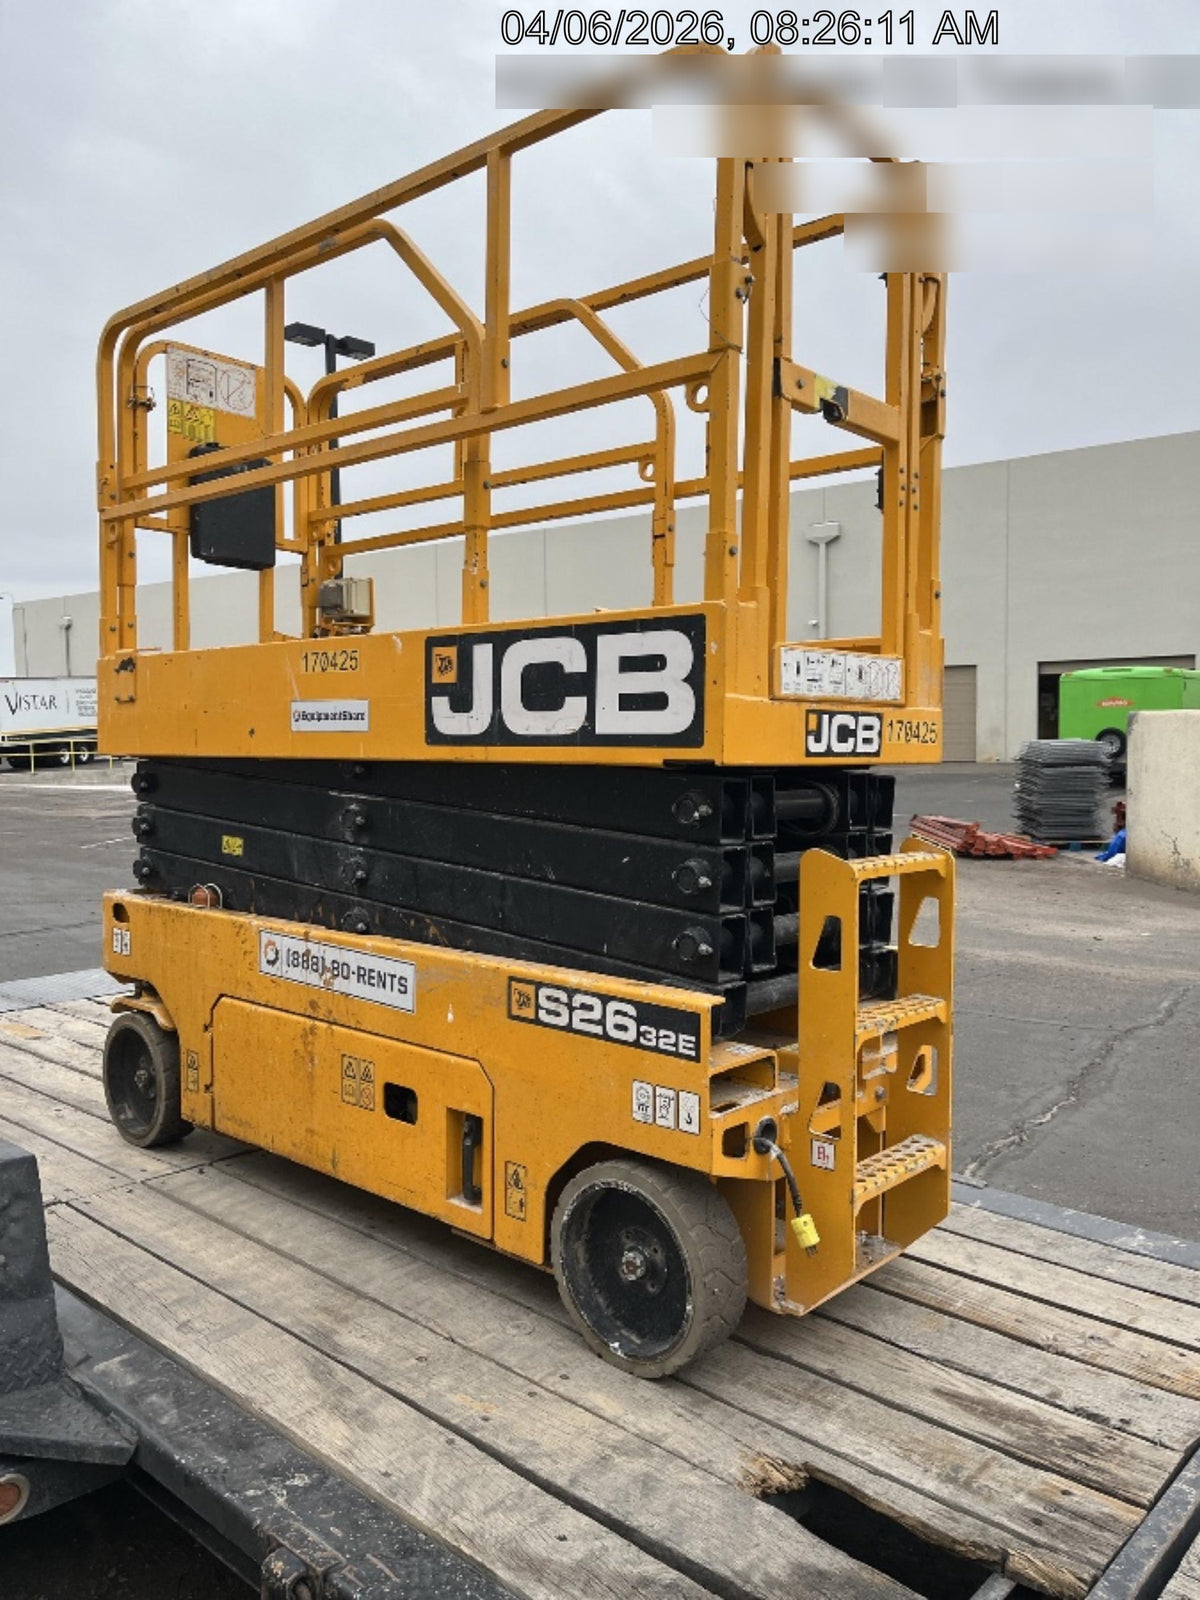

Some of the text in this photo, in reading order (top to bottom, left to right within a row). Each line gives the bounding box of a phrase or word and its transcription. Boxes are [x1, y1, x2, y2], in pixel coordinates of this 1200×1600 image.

[302, 649, 359, 673] 170425
[431, 629, 696, 736] JCB
[807, 713, 881, 753] JCB
[886, 719, 938, 744] 170425
